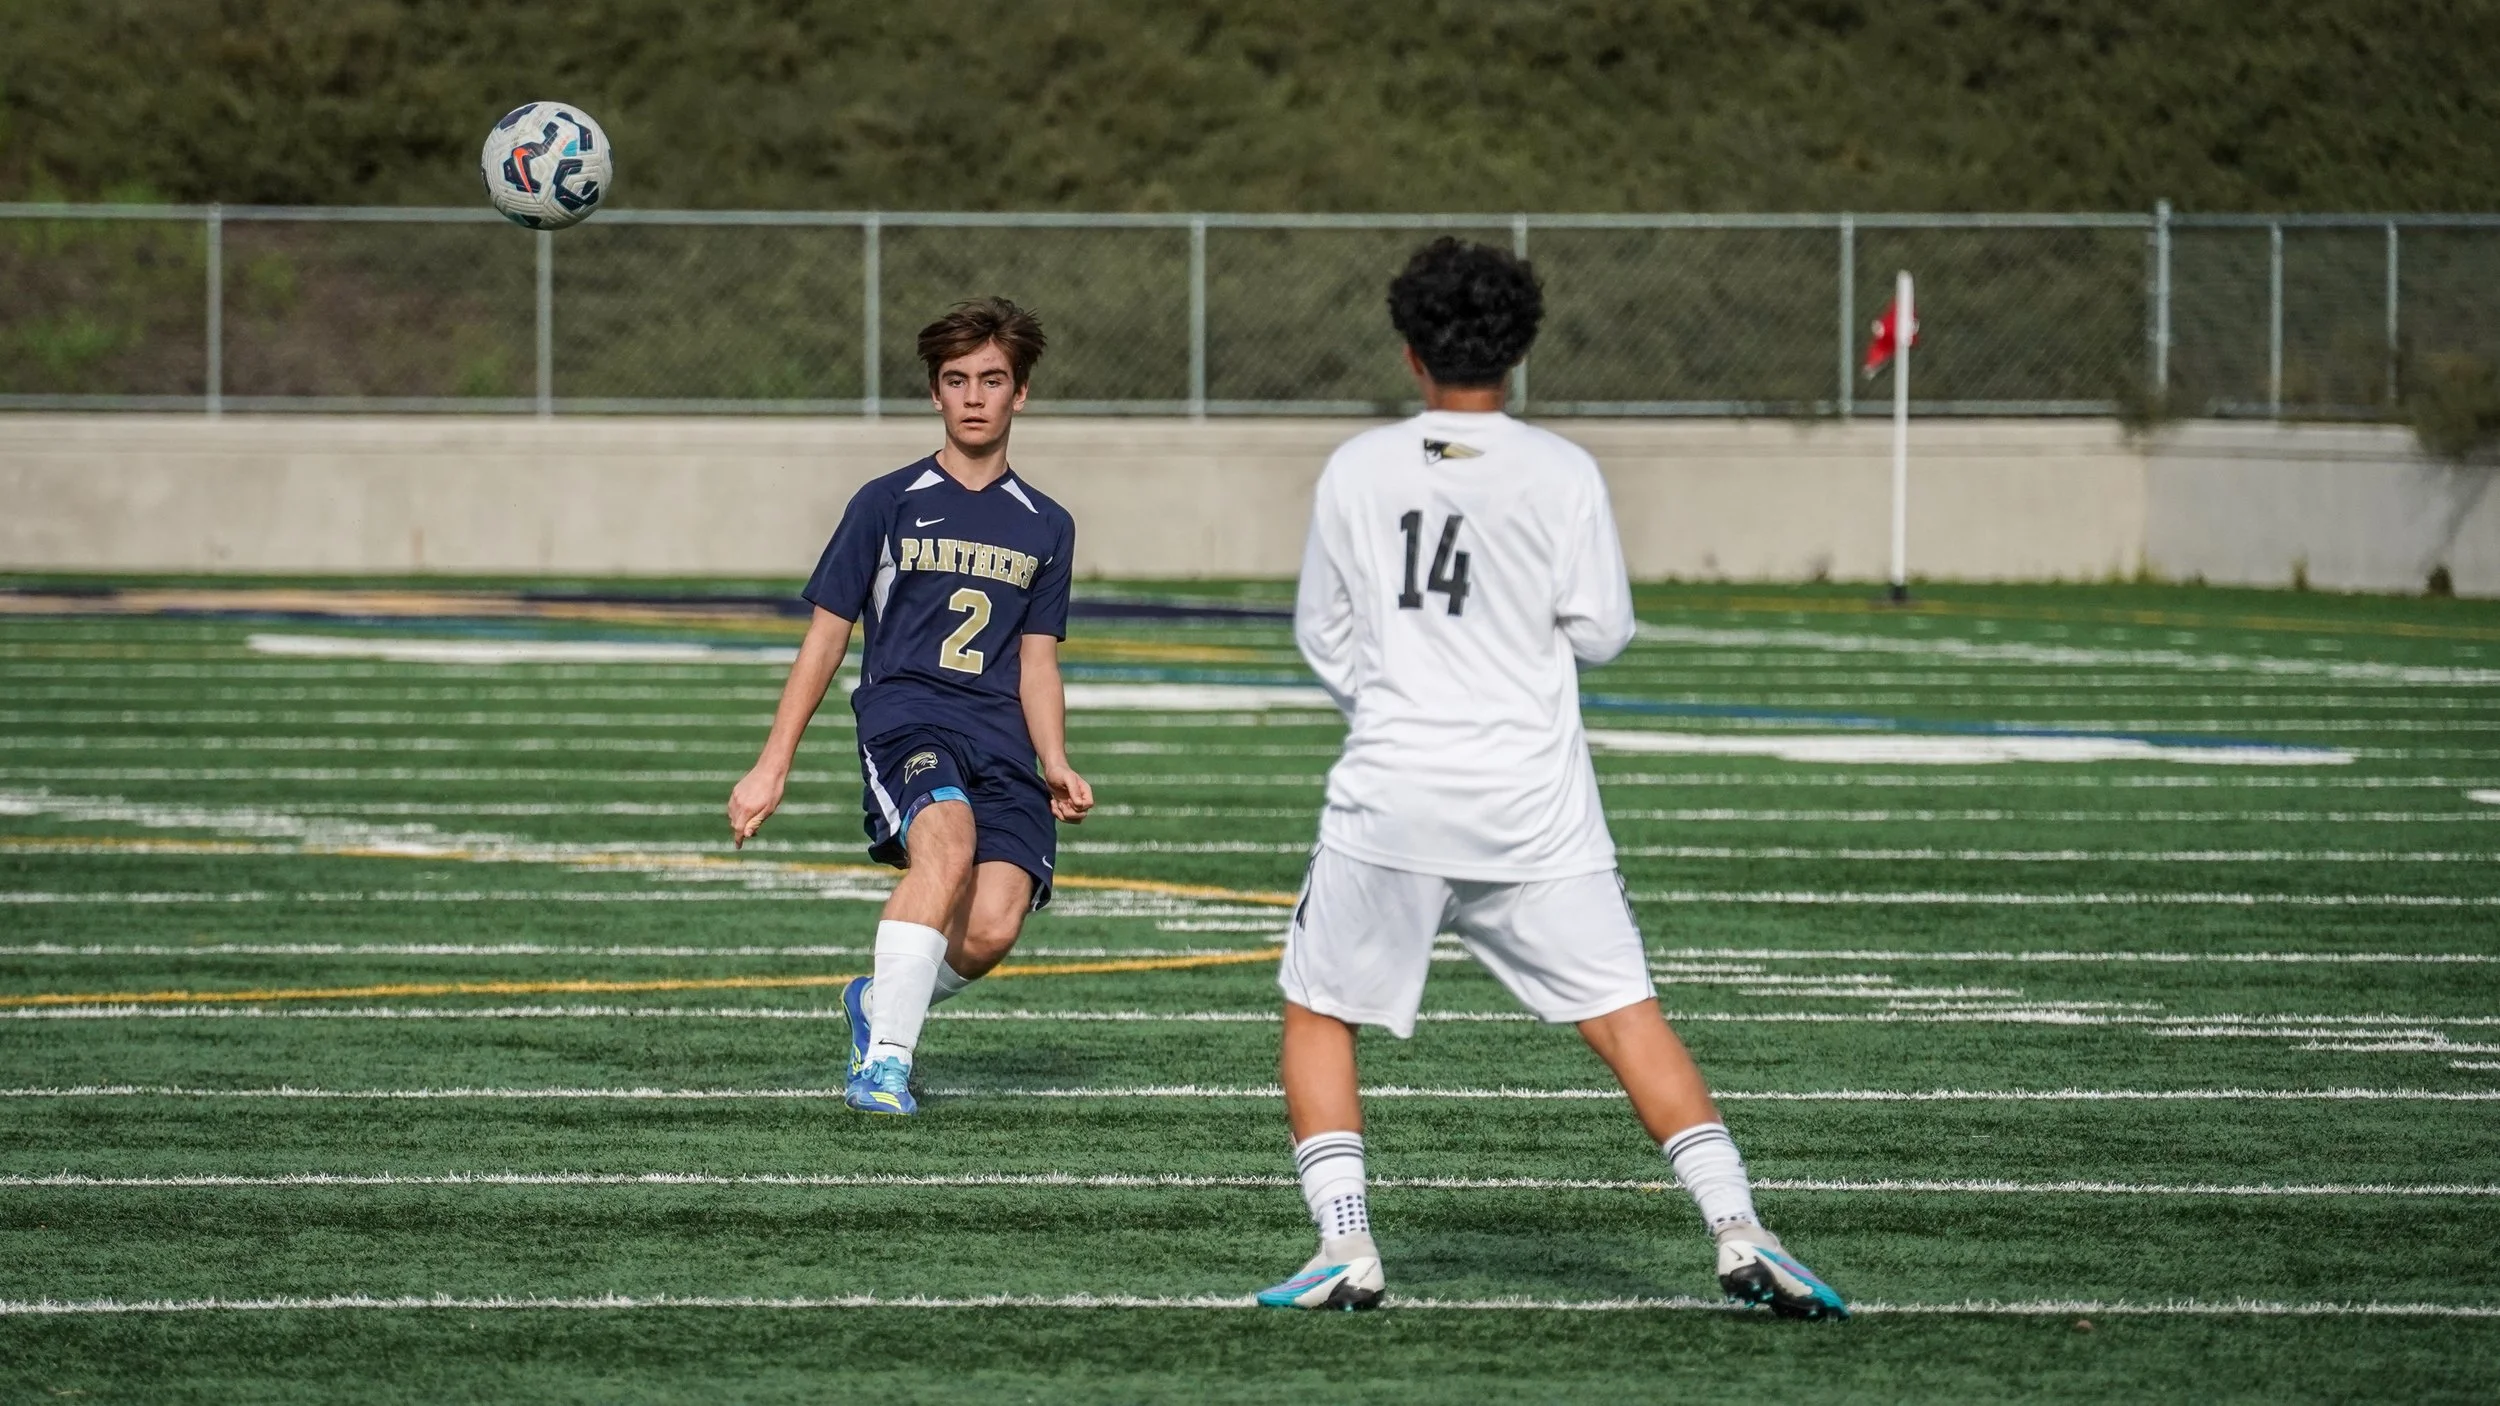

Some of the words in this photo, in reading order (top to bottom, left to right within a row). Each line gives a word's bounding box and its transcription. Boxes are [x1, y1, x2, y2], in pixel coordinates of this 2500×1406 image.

[900, 538, 1039, 590] PANTHERS
[1399, 509, 1471, 616] 14
[939, 587, 993, 675] 2
